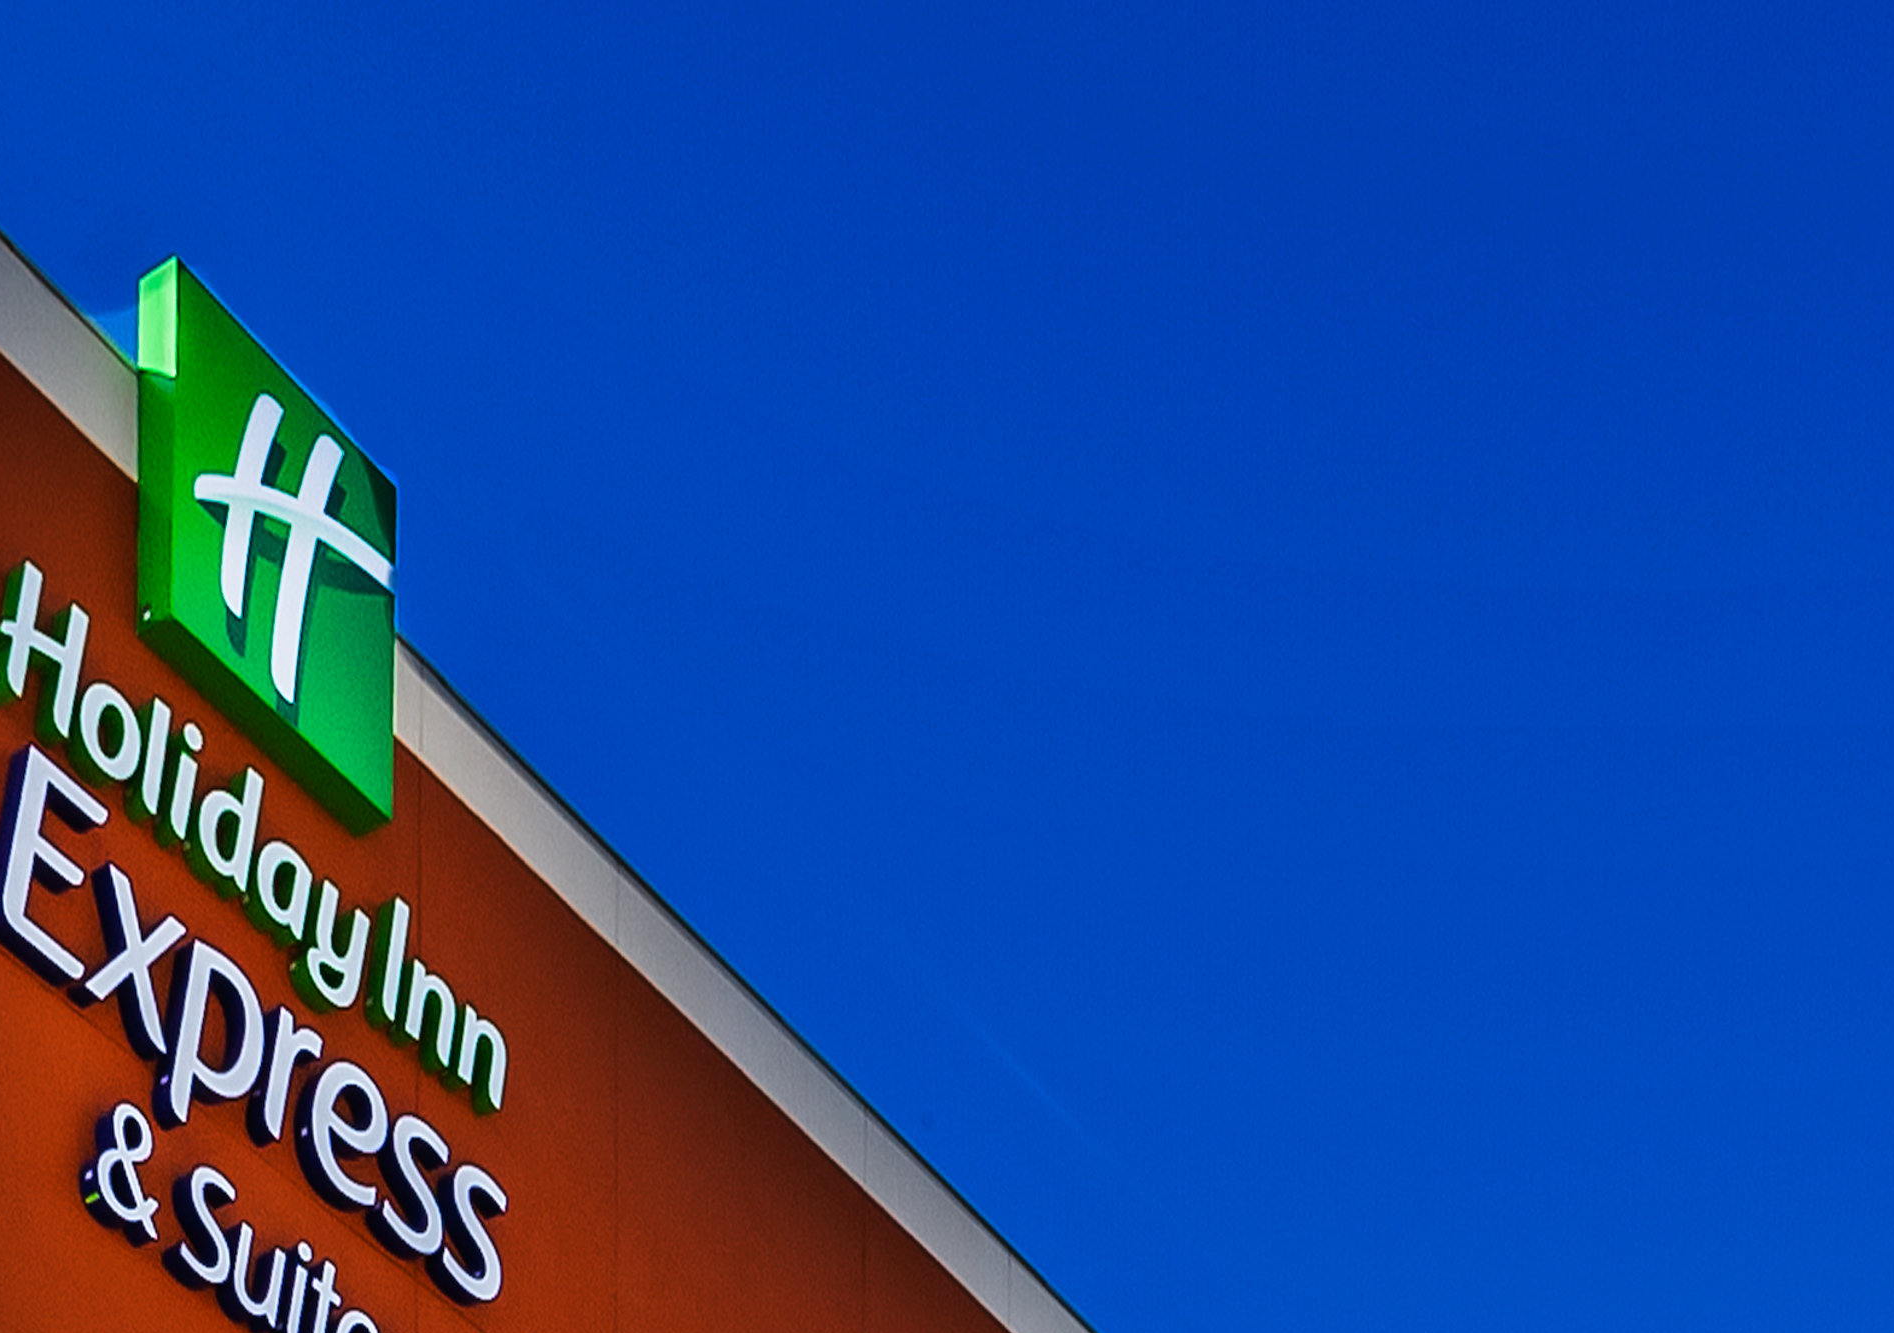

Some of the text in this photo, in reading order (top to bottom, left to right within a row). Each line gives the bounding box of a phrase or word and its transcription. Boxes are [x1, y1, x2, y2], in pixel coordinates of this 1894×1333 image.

[0, 559, 508, 1112] Holiday Inn
[1, 743, 507, 1303] Express
[96, 1102, 159, 1240] &
